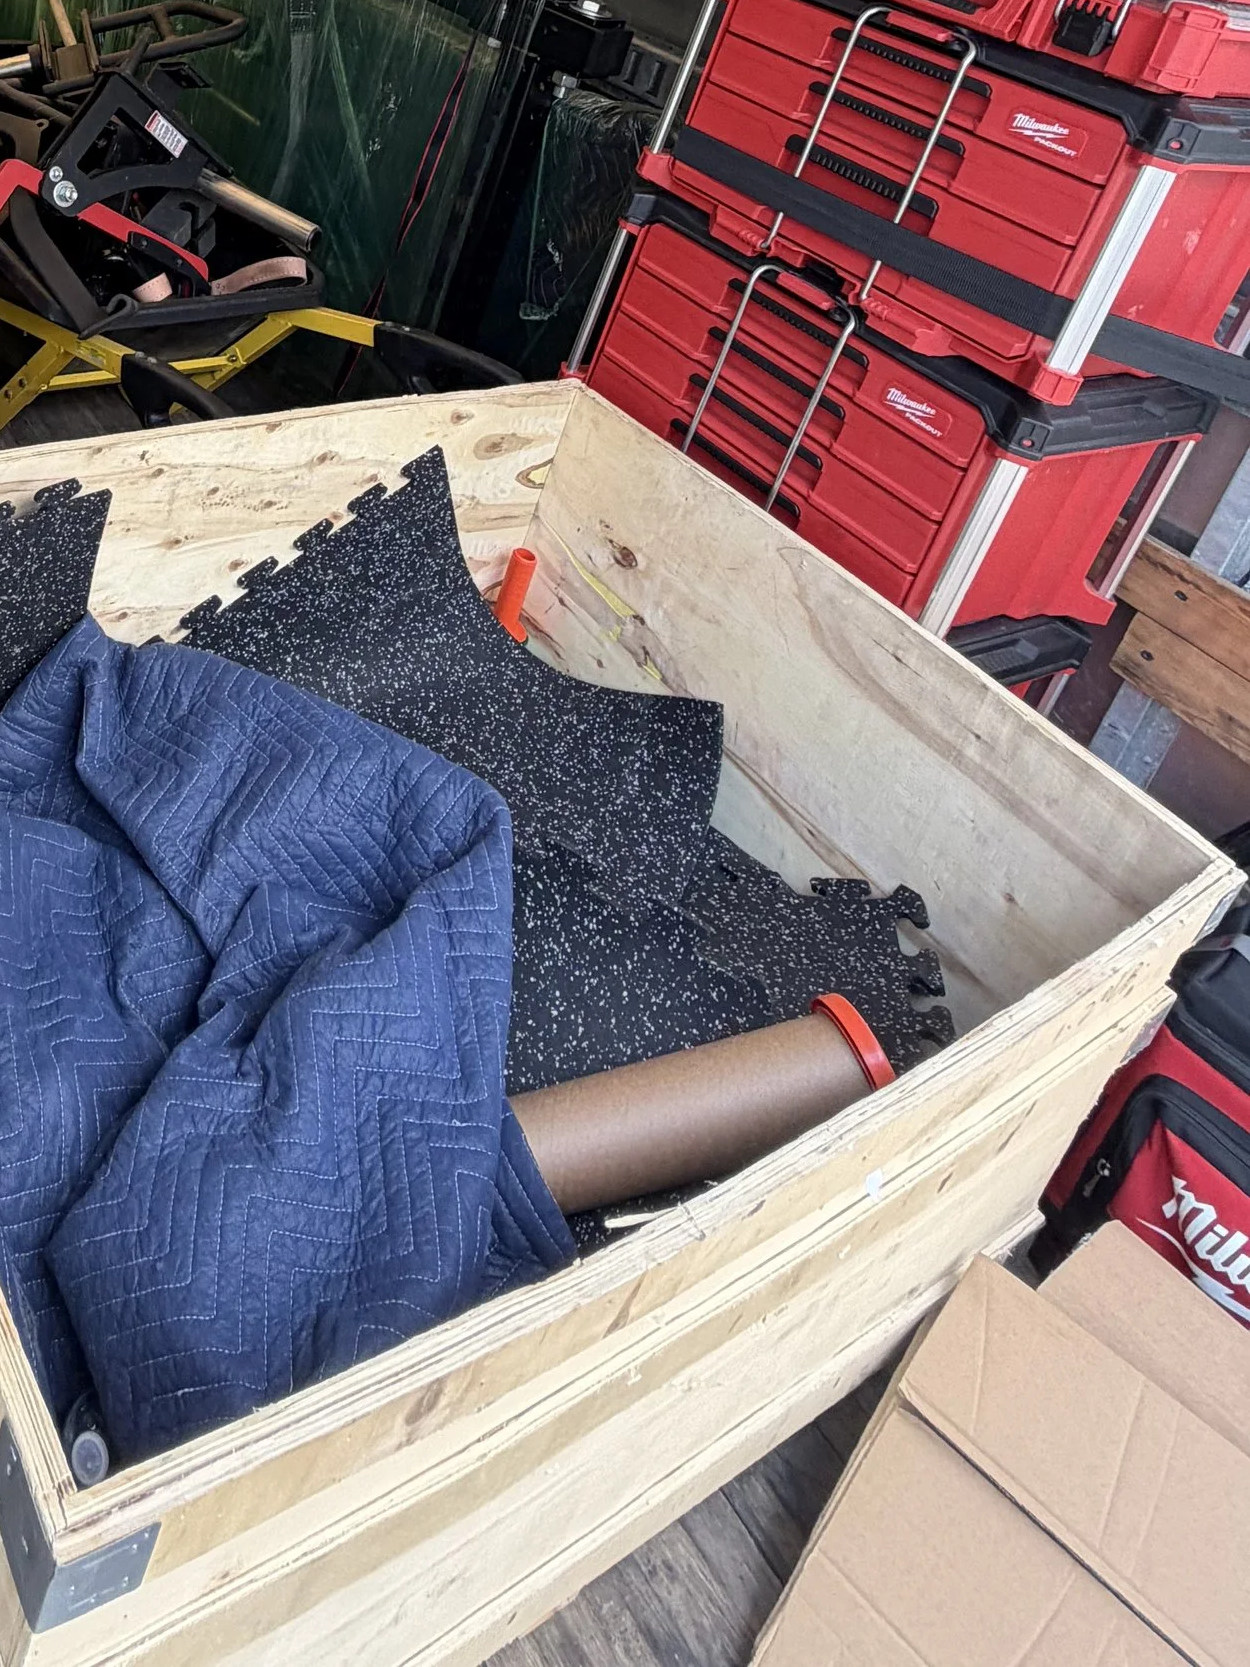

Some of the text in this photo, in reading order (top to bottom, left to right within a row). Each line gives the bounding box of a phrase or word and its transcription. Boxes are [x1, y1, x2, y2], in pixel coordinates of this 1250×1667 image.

[1012, 113, 1070, 135] Milwaukee
[1033, 136, 1078, 157] PACKOUT
[886, 387, 937, 416] Milwaukee
[904, 412, 943, 438] PACKOUT
